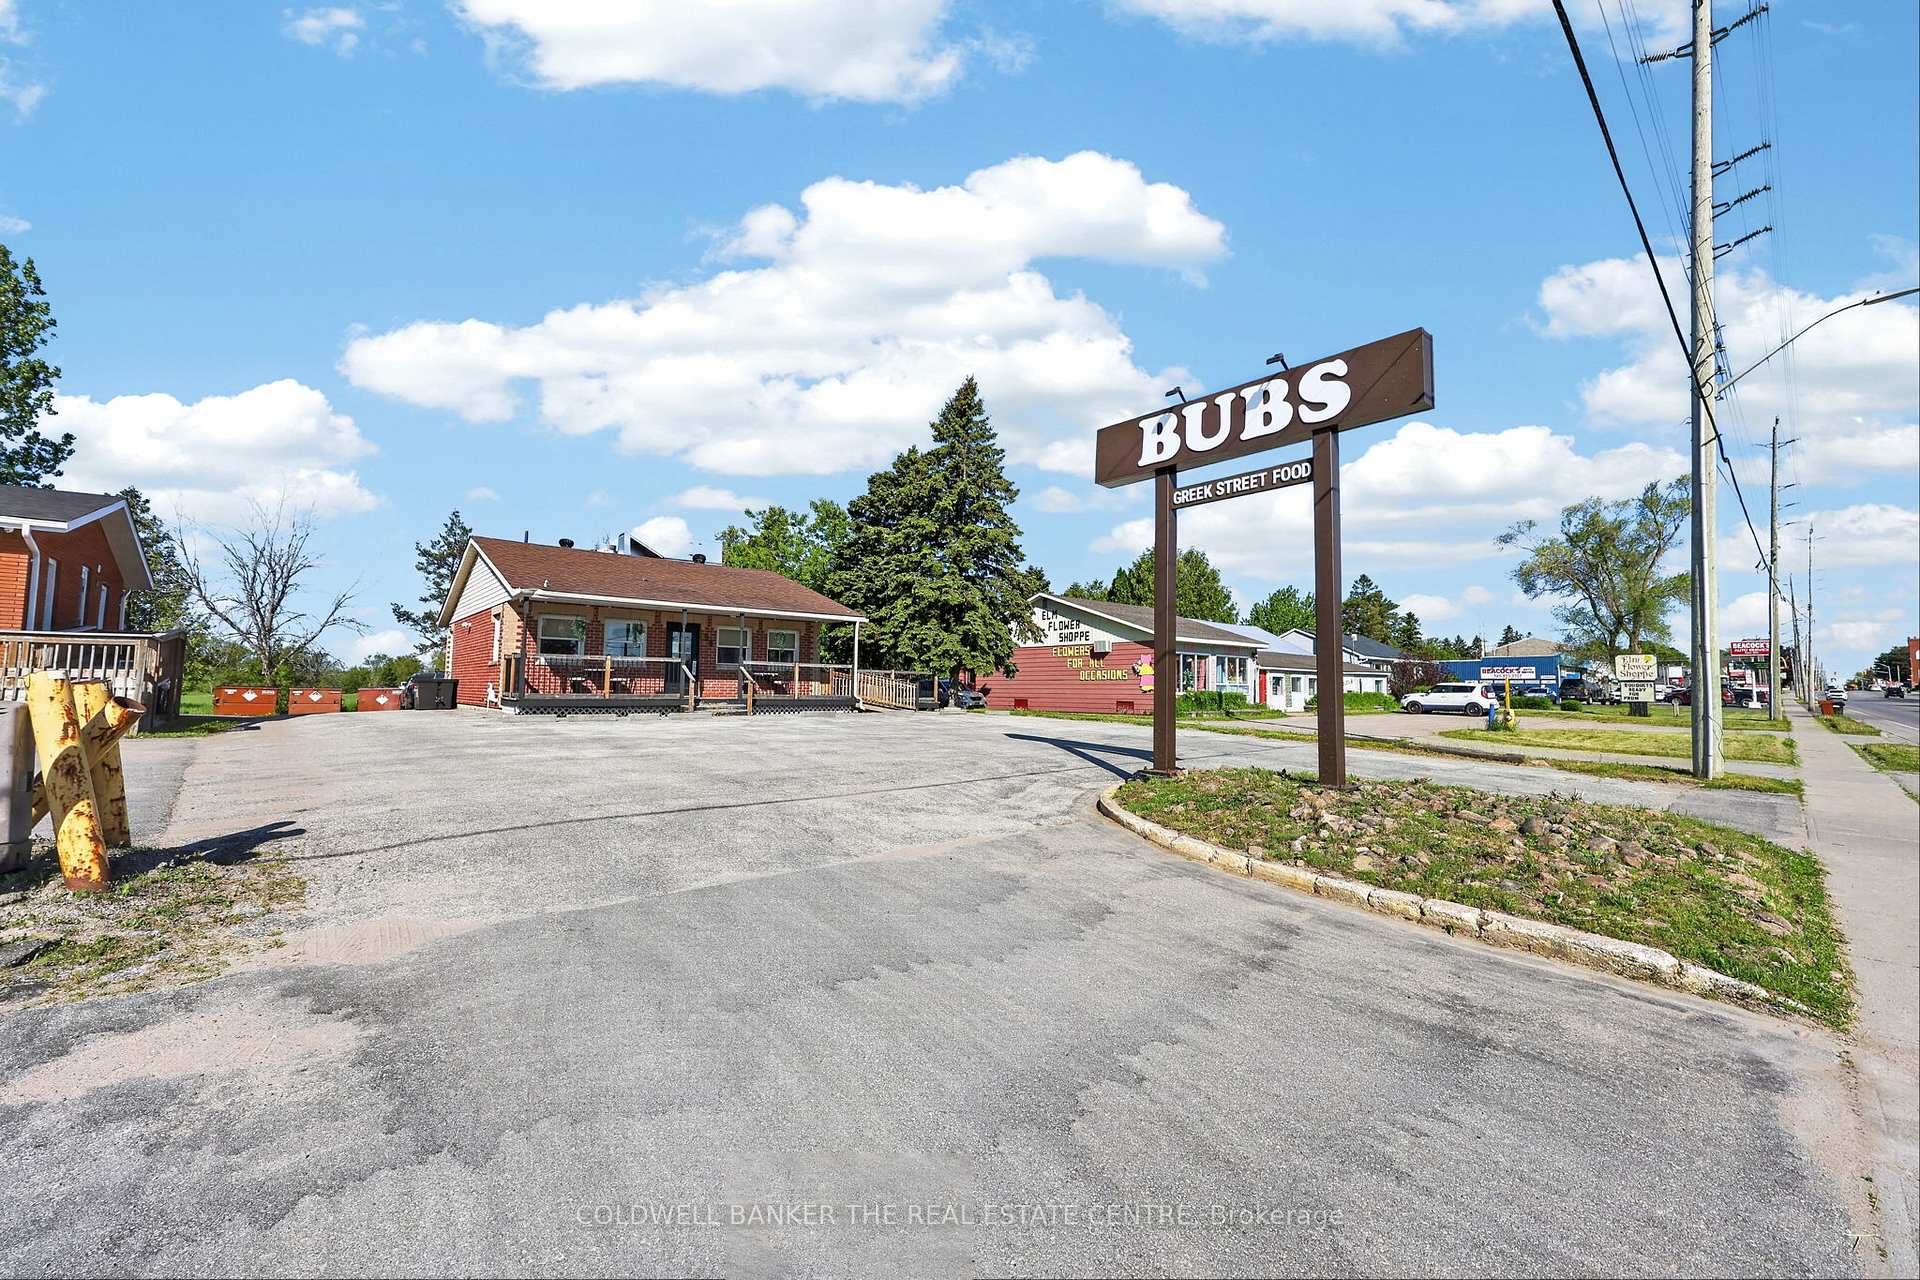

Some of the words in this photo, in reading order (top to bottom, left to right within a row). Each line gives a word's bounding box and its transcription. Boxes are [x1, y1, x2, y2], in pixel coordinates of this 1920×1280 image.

[1138, 358, 1351, 467] BUBS
[1173, 485, 1213, 505] GREEK
[1216, 472, 1268, 496] STREET
[1272, 462, 1312, 488] FOOD
[1041, 610, 1058, 620] ELM
[1048, 620, 1080, 631] FLOWER
[1059, 631, 1090, 642] SHOPPE
[1052, 646, 1090, 656] FLOWERS
[1067, 658, 1082, 668] FOR
[1089, 658, 1104, 667] ALL
[1080, 670, 1128, 680] OCCASIONS
